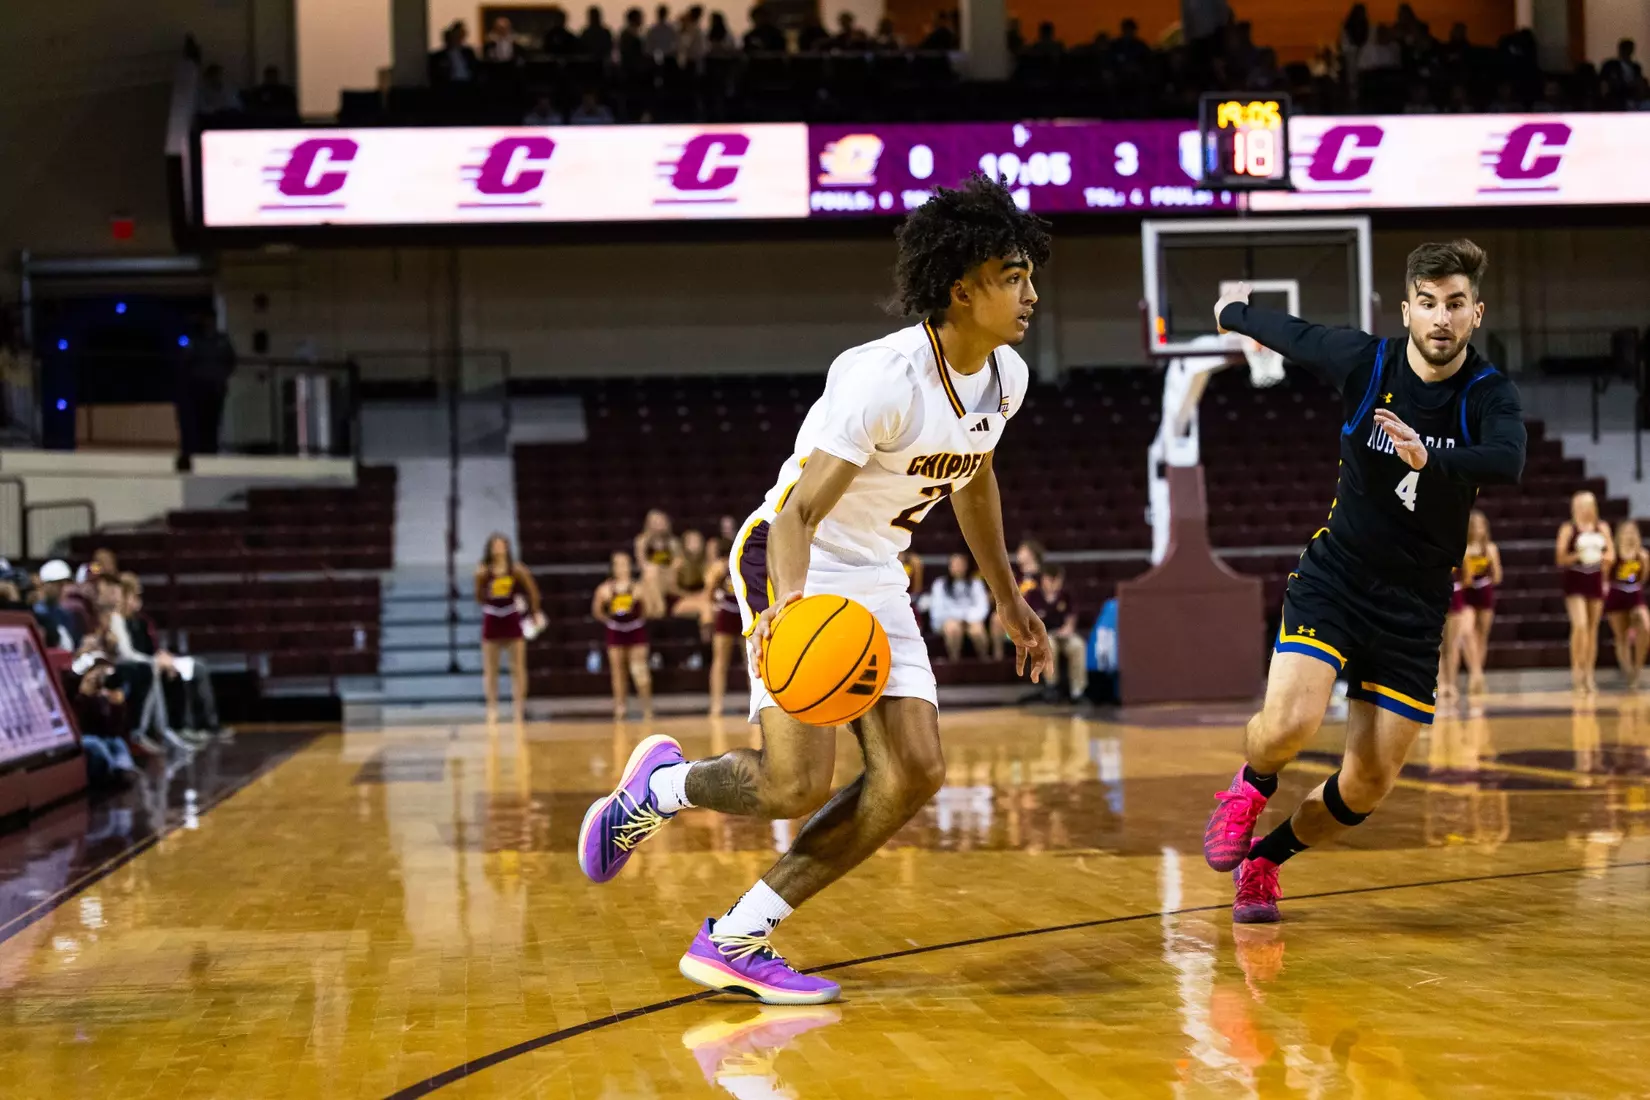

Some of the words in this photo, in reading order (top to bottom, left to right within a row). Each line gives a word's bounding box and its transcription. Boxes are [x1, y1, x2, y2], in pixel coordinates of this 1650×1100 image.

[1217, 101, 1282, 130] 19:05
[277, 136, 359, 196] C
[475, 135, 556, 195] C
[671, 132, 751, 191] C
[908, 145, 933, 179] 0
[979, 152, 1072, 186] 19:05
[1113, 141, 1140, 176] 3
[1234, 131, 1274, 176] 18
[1308, 124, 1385, 181] C
[1495, 122, 1572, 180] C
[890, 482, 955, 534] 2
[1394, 470, 1421, 512] 4
